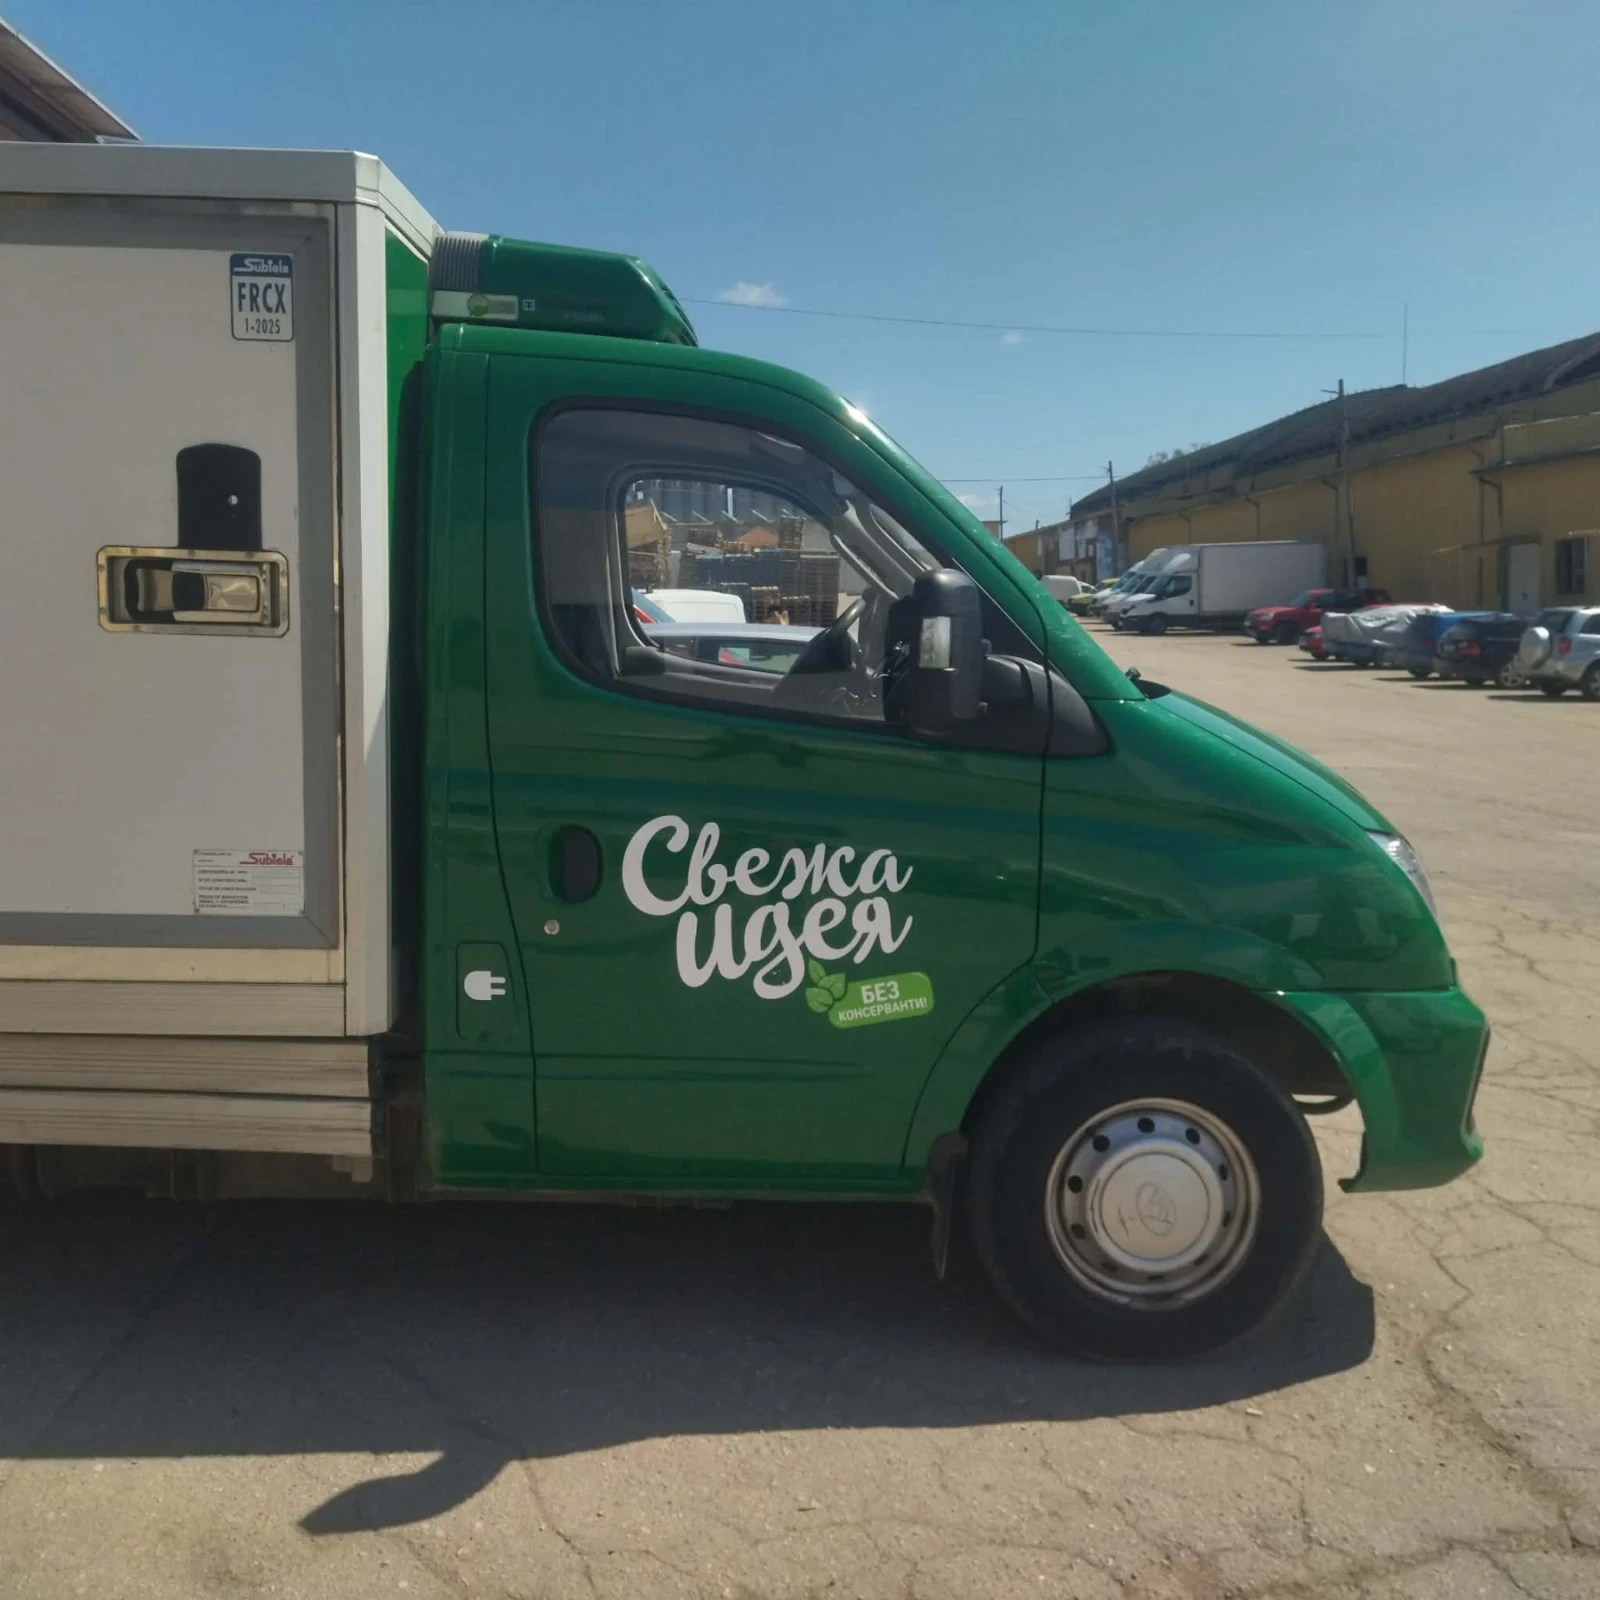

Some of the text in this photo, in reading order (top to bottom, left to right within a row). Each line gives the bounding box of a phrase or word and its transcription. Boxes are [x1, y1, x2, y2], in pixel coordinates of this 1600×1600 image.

[237, 282, 286, 314] FRCX
[622, 815, 913, 916] Свежа
[676, 896, 913, 999] идея
[861, 980, 900, 1005] БЕЗ
[838, 997, 928, 1022] КОНСЕРВАНТИ!
